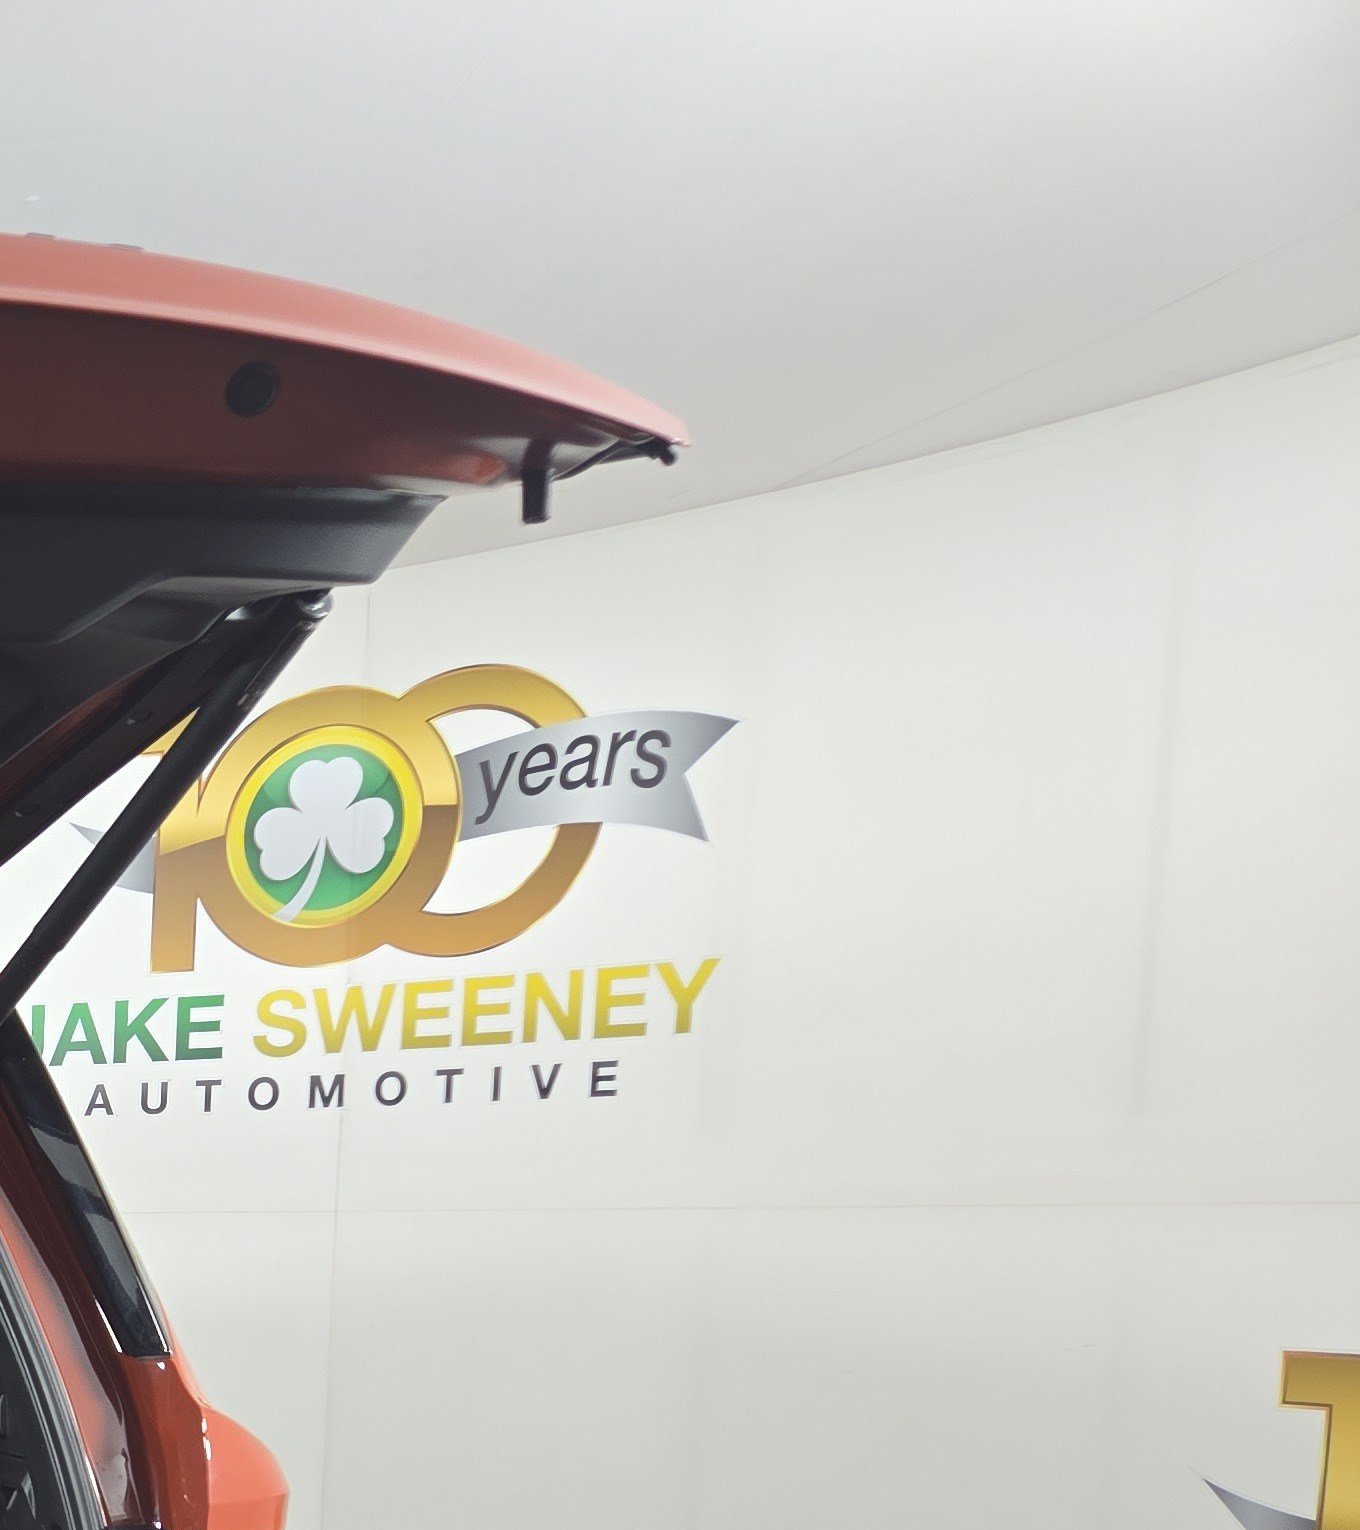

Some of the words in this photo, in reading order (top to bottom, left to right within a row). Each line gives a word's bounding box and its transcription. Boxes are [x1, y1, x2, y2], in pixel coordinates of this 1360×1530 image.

[475, 728, 669, 825] years
[253, 957, 721, 1058] SWEENEY
[84, 1060, 619, 1116] AUTOMOTIVE
